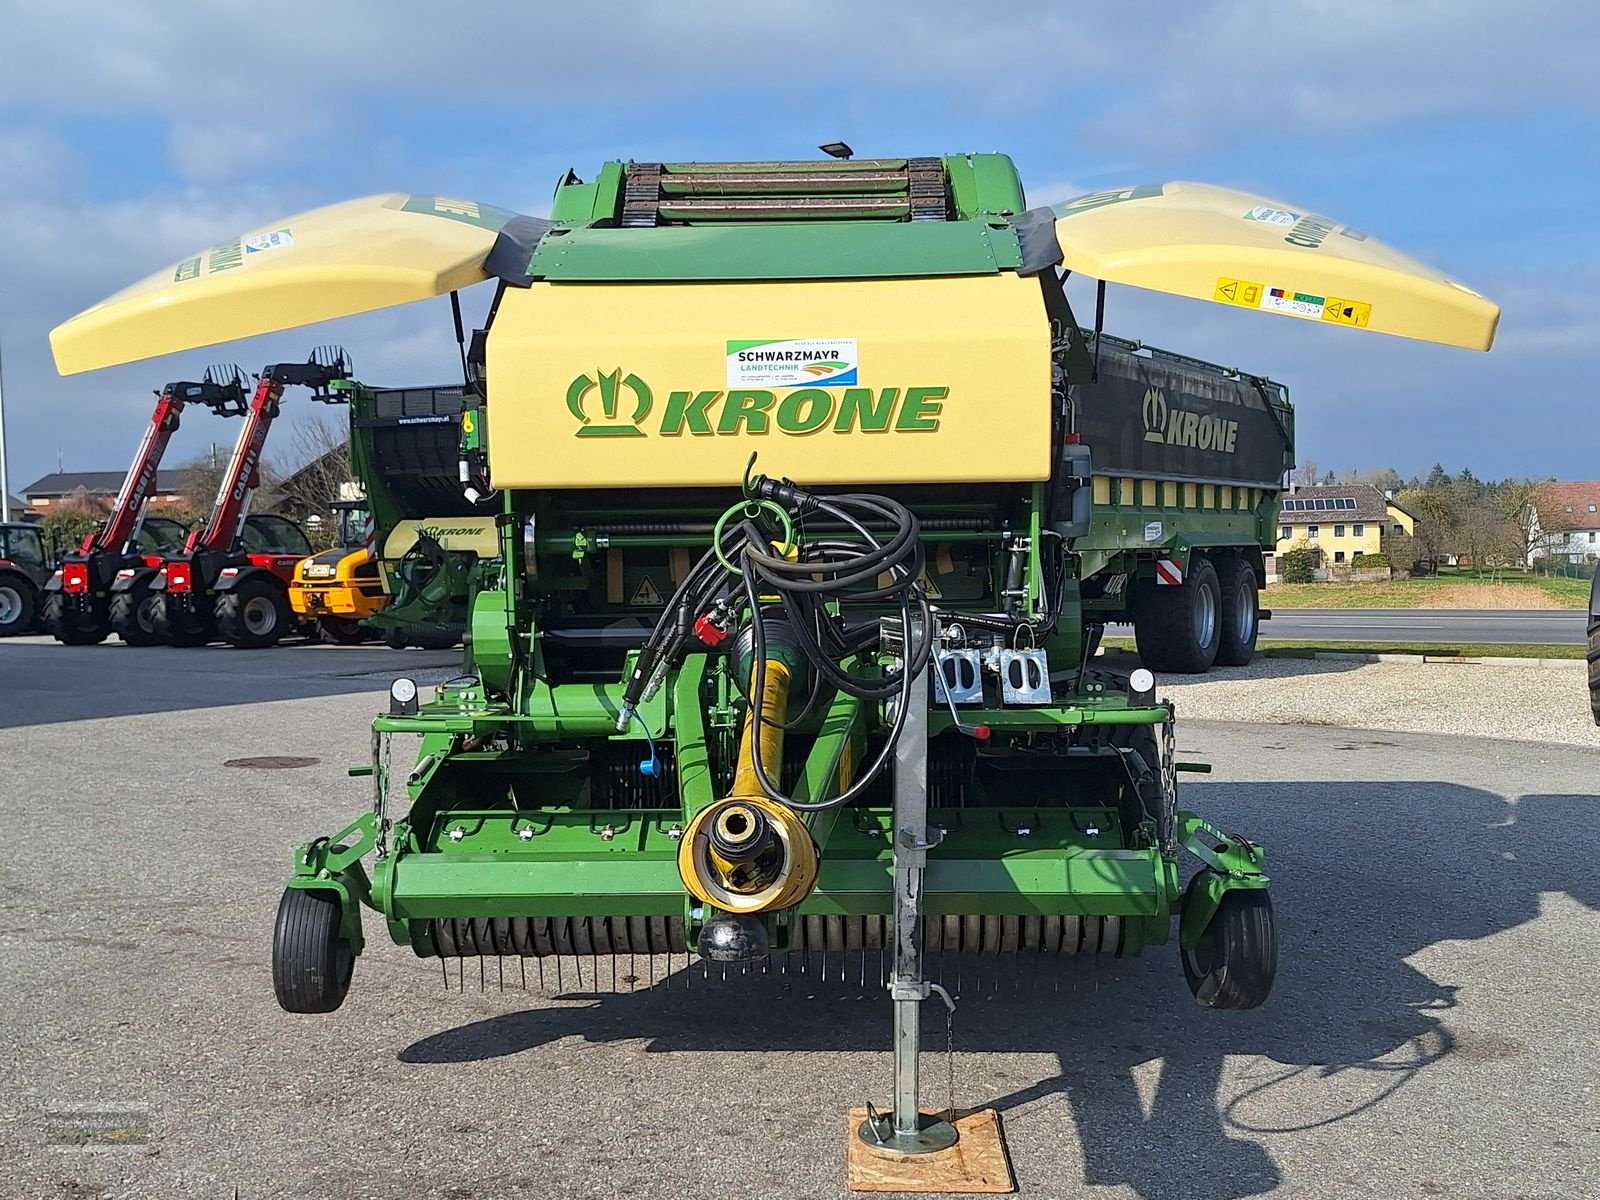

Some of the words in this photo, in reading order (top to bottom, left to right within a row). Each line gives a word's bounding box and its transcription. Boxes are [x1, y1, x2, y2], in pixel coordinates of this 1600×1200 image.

[738, 350, 839, 362] SCHWARZMAYR
[740, 364, 799, 372] LANDTECHNIK
[659, 386, 950, 436] KRONE
[1166, 409, 1238, 453] KRONE
[129, 475, 148, 512] CASE
[234, 464, 252, 501] CASE
[438, 527, 486, 536] KRONE
